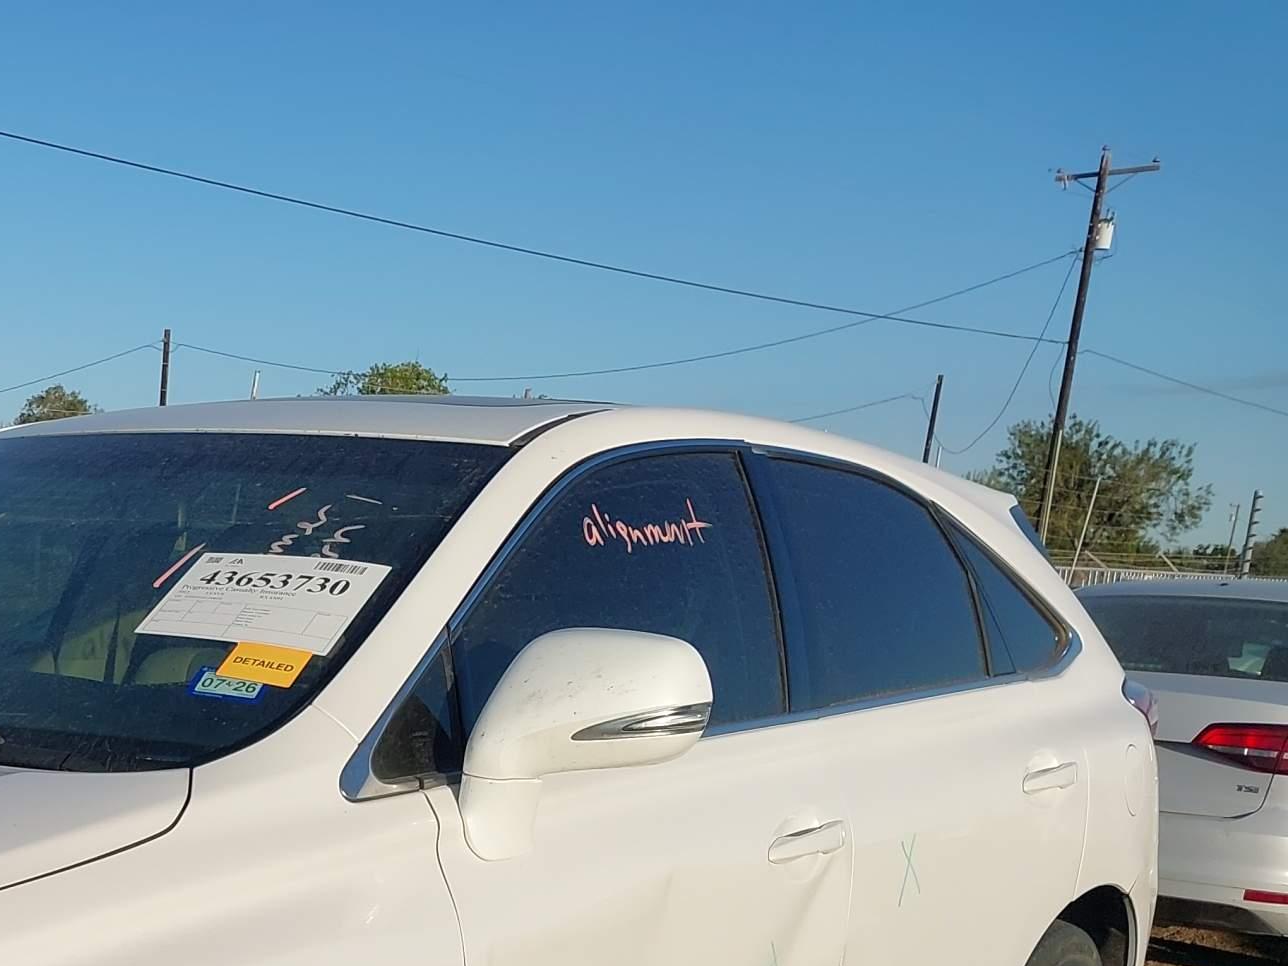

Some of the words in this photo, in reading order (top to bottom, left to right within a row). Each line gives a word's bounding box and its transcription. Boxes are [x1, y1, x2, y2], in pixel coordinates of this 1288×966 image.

[200, 569, 351, 596] 43653730
[232, 656, 295, 672] DETAILED
[201, 677, 227, 689] 07
[232, 681, 258, 694] 26
